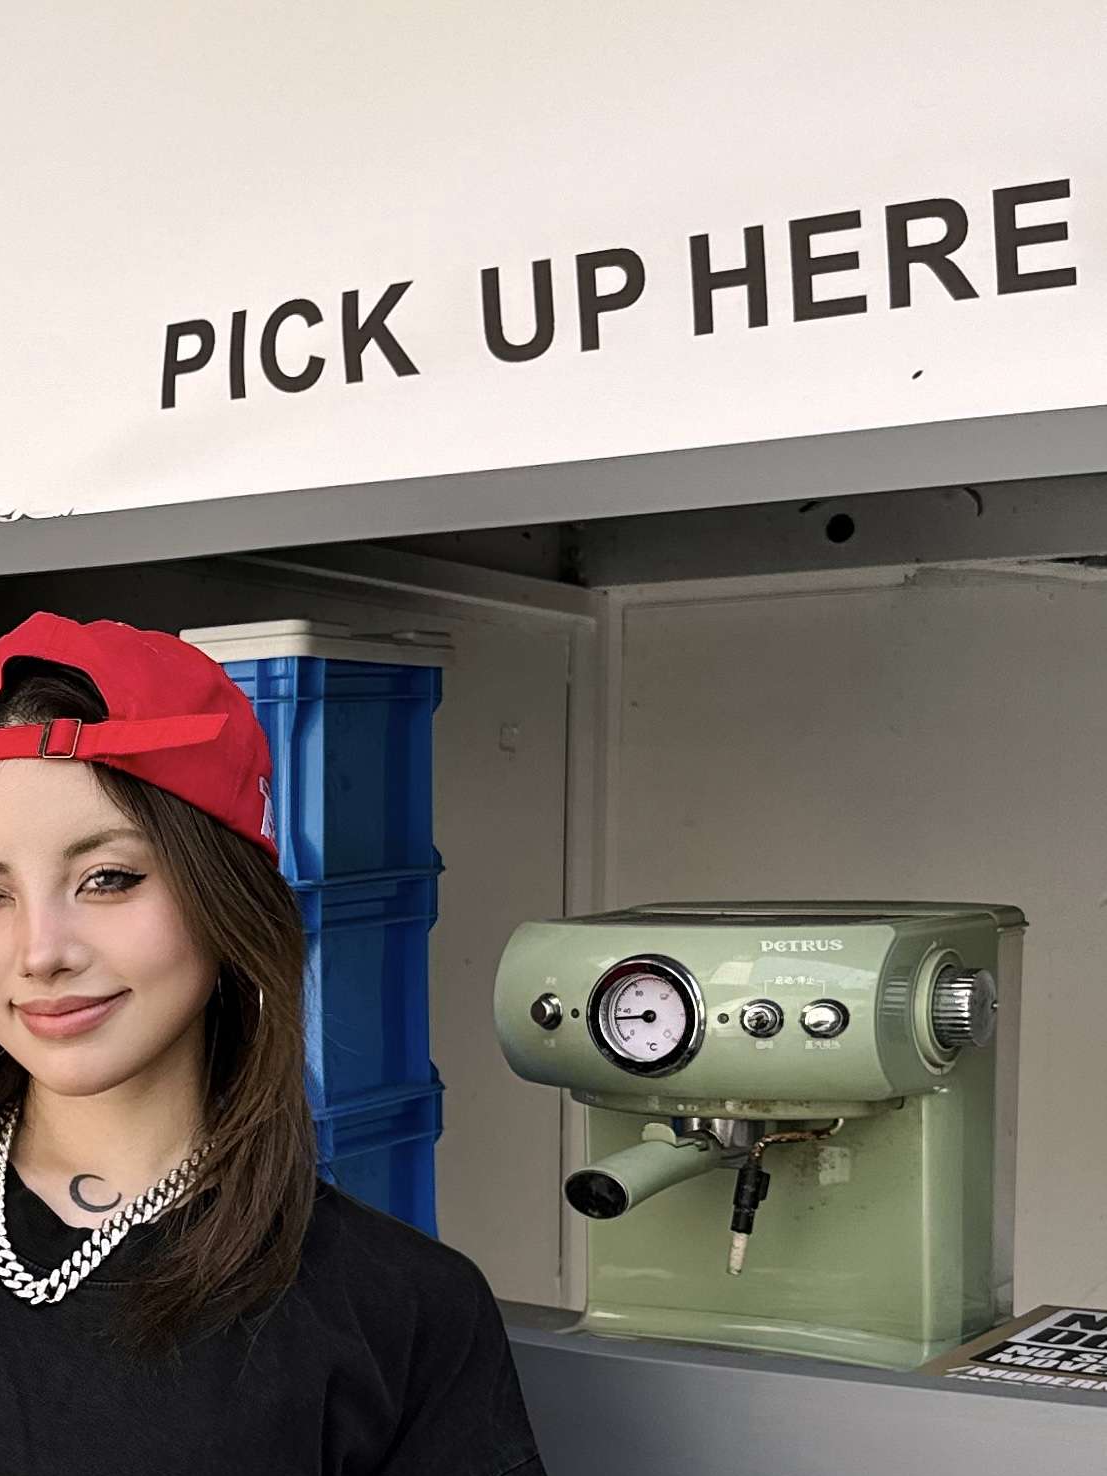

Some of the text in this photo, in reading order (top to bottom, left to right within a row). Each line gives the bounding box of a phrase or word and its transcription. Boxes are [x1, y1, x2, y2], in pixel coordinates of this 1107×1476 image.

[161, 178, 1078, 409] PICK UP HERE
[760, 938, 844, 953] PETRUS
